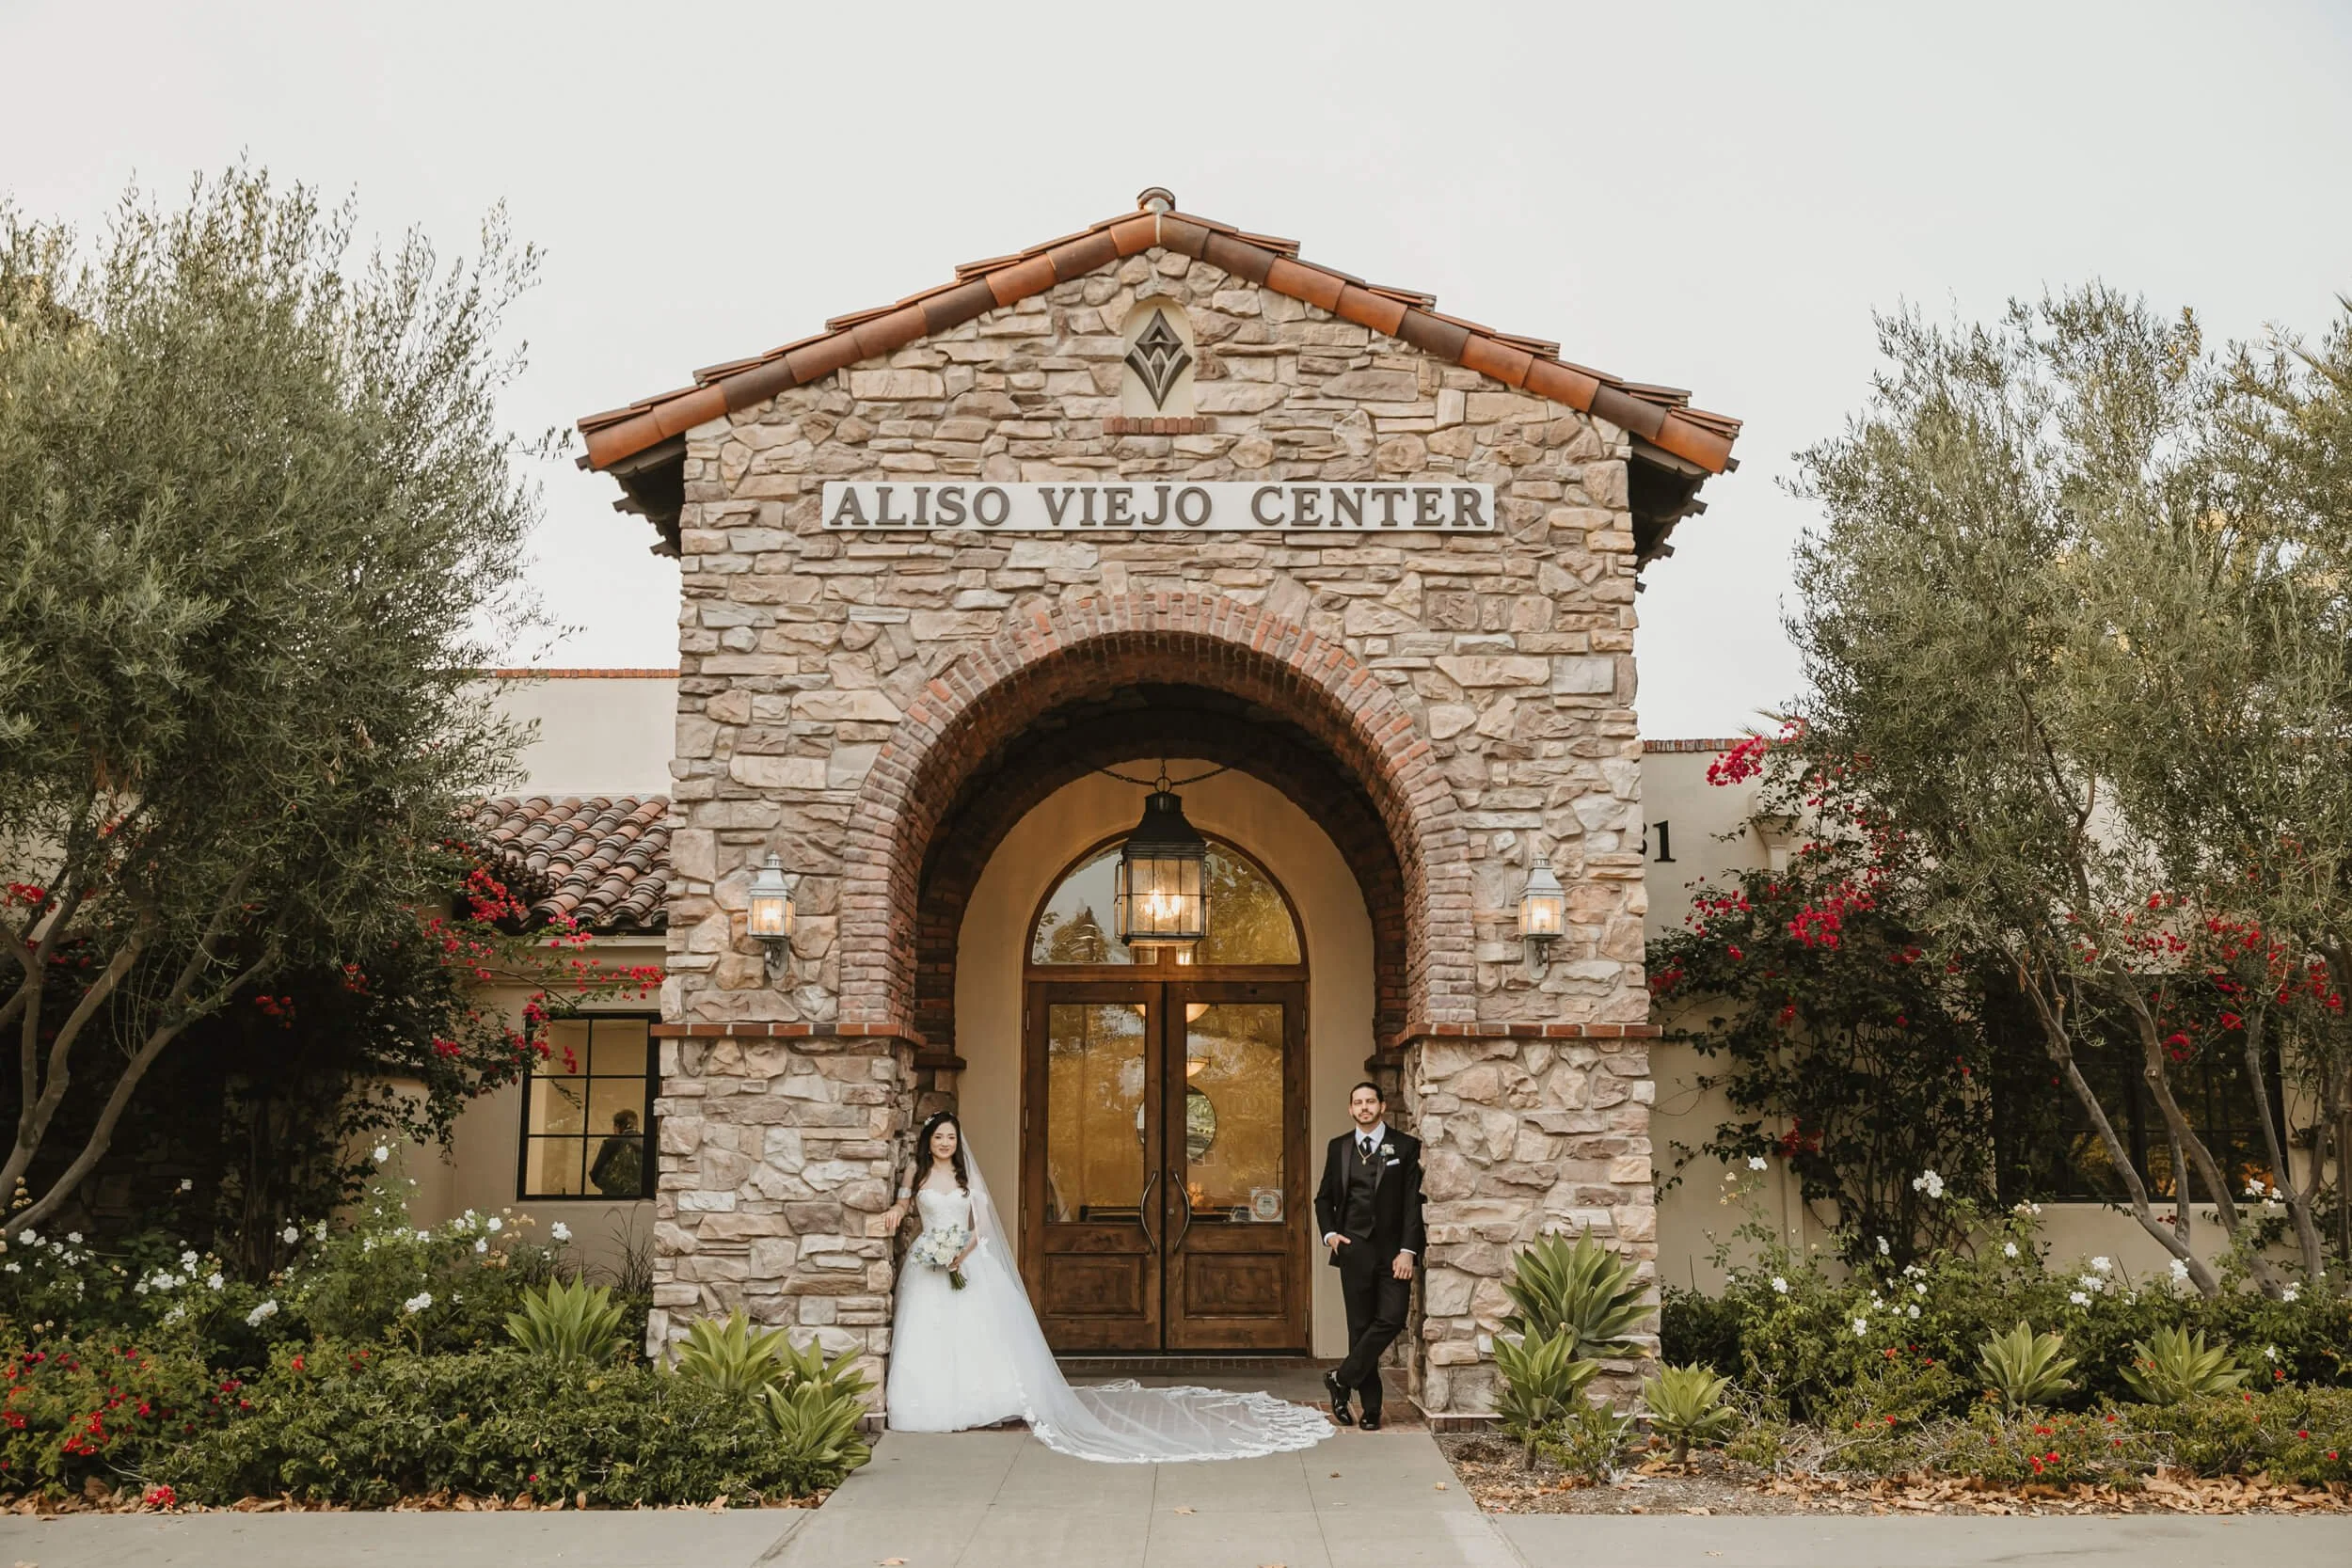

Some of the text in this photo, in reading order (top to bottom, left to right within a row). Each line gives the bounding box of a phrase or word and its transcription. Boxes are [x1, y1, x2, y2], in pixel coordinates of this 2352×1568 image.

[829, 485, 1486, 527] ALISO VIEJO CENTER
[1639, 819, 1677, 863] 1
